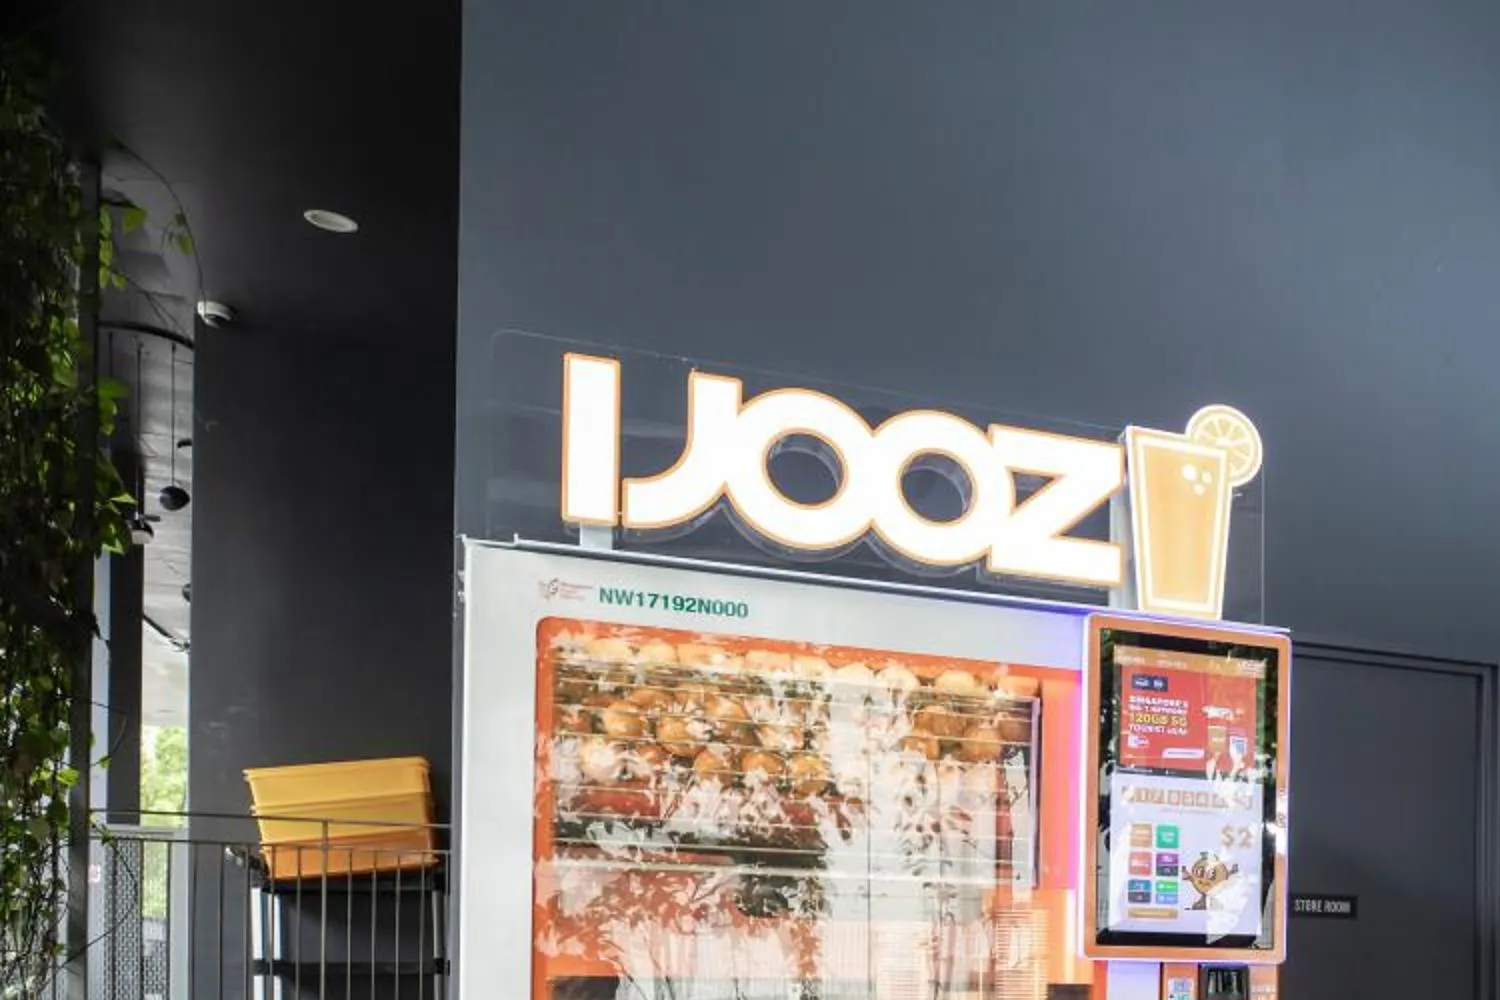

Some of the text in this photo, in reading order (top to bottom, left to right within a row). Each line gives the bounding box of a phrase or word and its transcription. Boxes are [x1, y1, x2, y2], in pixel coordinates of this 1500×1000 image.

[561, 352, 1125, 586] IJOOZ
[599, 587, 749, 618] NW17192N000
[1294, 899, 1322, 913] STORE
